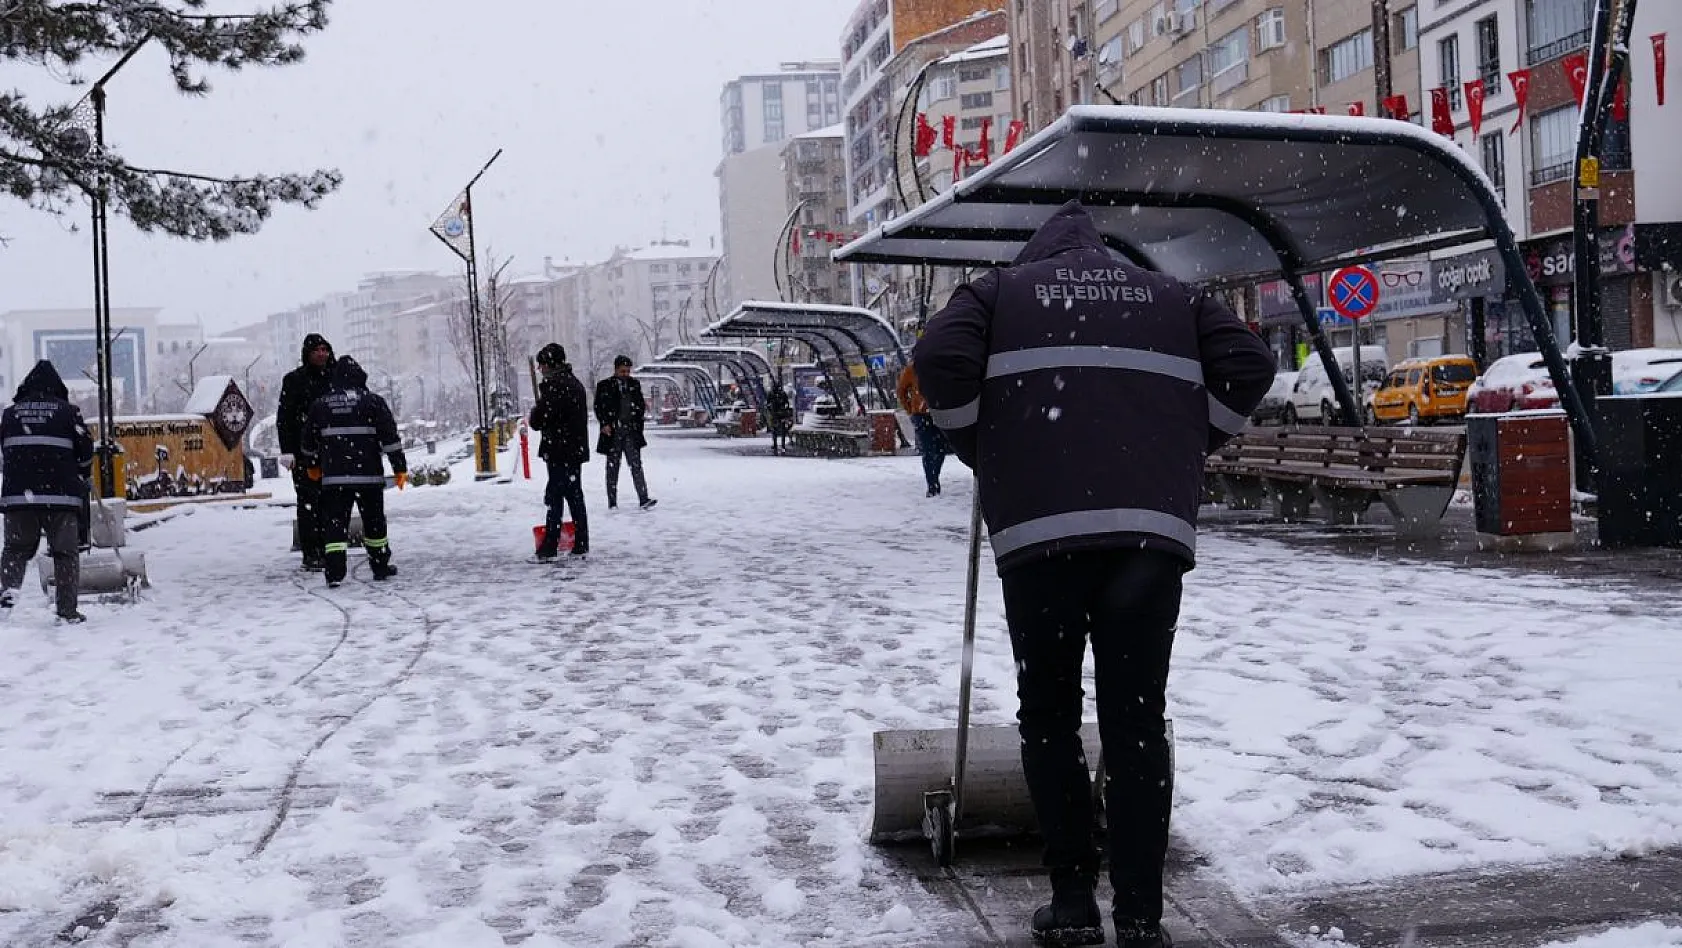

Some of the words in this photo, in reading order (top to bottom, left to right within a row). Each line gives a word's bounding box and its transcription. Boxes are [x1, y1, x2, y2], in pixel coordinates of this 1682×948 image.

[1055, 267, 1128, 282] ELAZIĞ
[1467, 257, 1491, 287] optik
[1034, 283, 1154, 303] BELEDİYESİ
